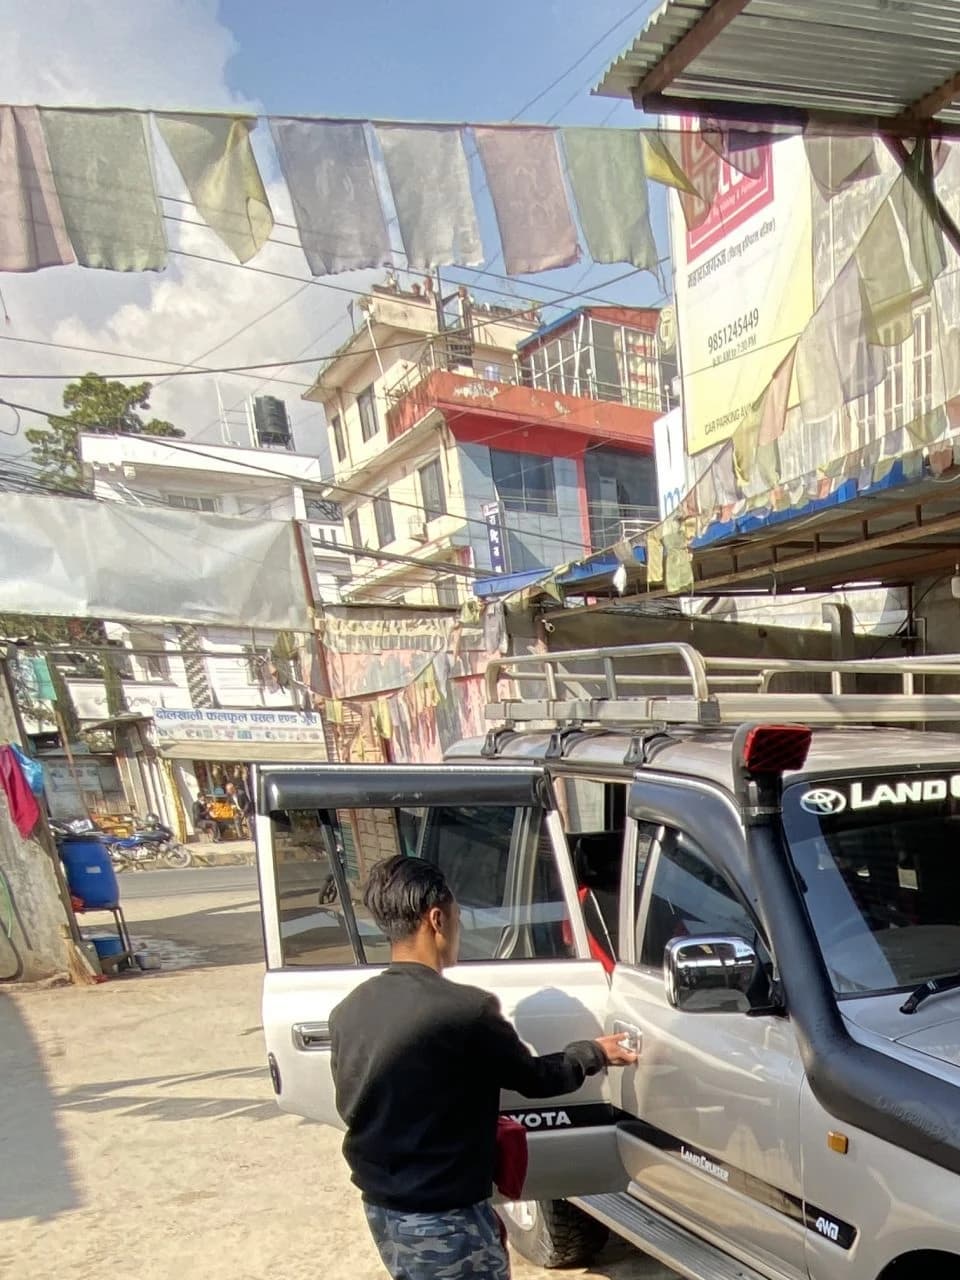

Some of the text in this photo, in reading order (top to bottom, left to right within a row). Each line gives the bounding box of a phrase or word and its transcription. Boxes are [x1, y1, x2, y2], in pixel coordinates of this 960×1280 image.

[708, 307, 759, 354] 9851245449
[850, 779, 947, 809] LAND
[501, 1111, 572, 1128] YOTA
[815, 1216, 840, 1240] 4WD
